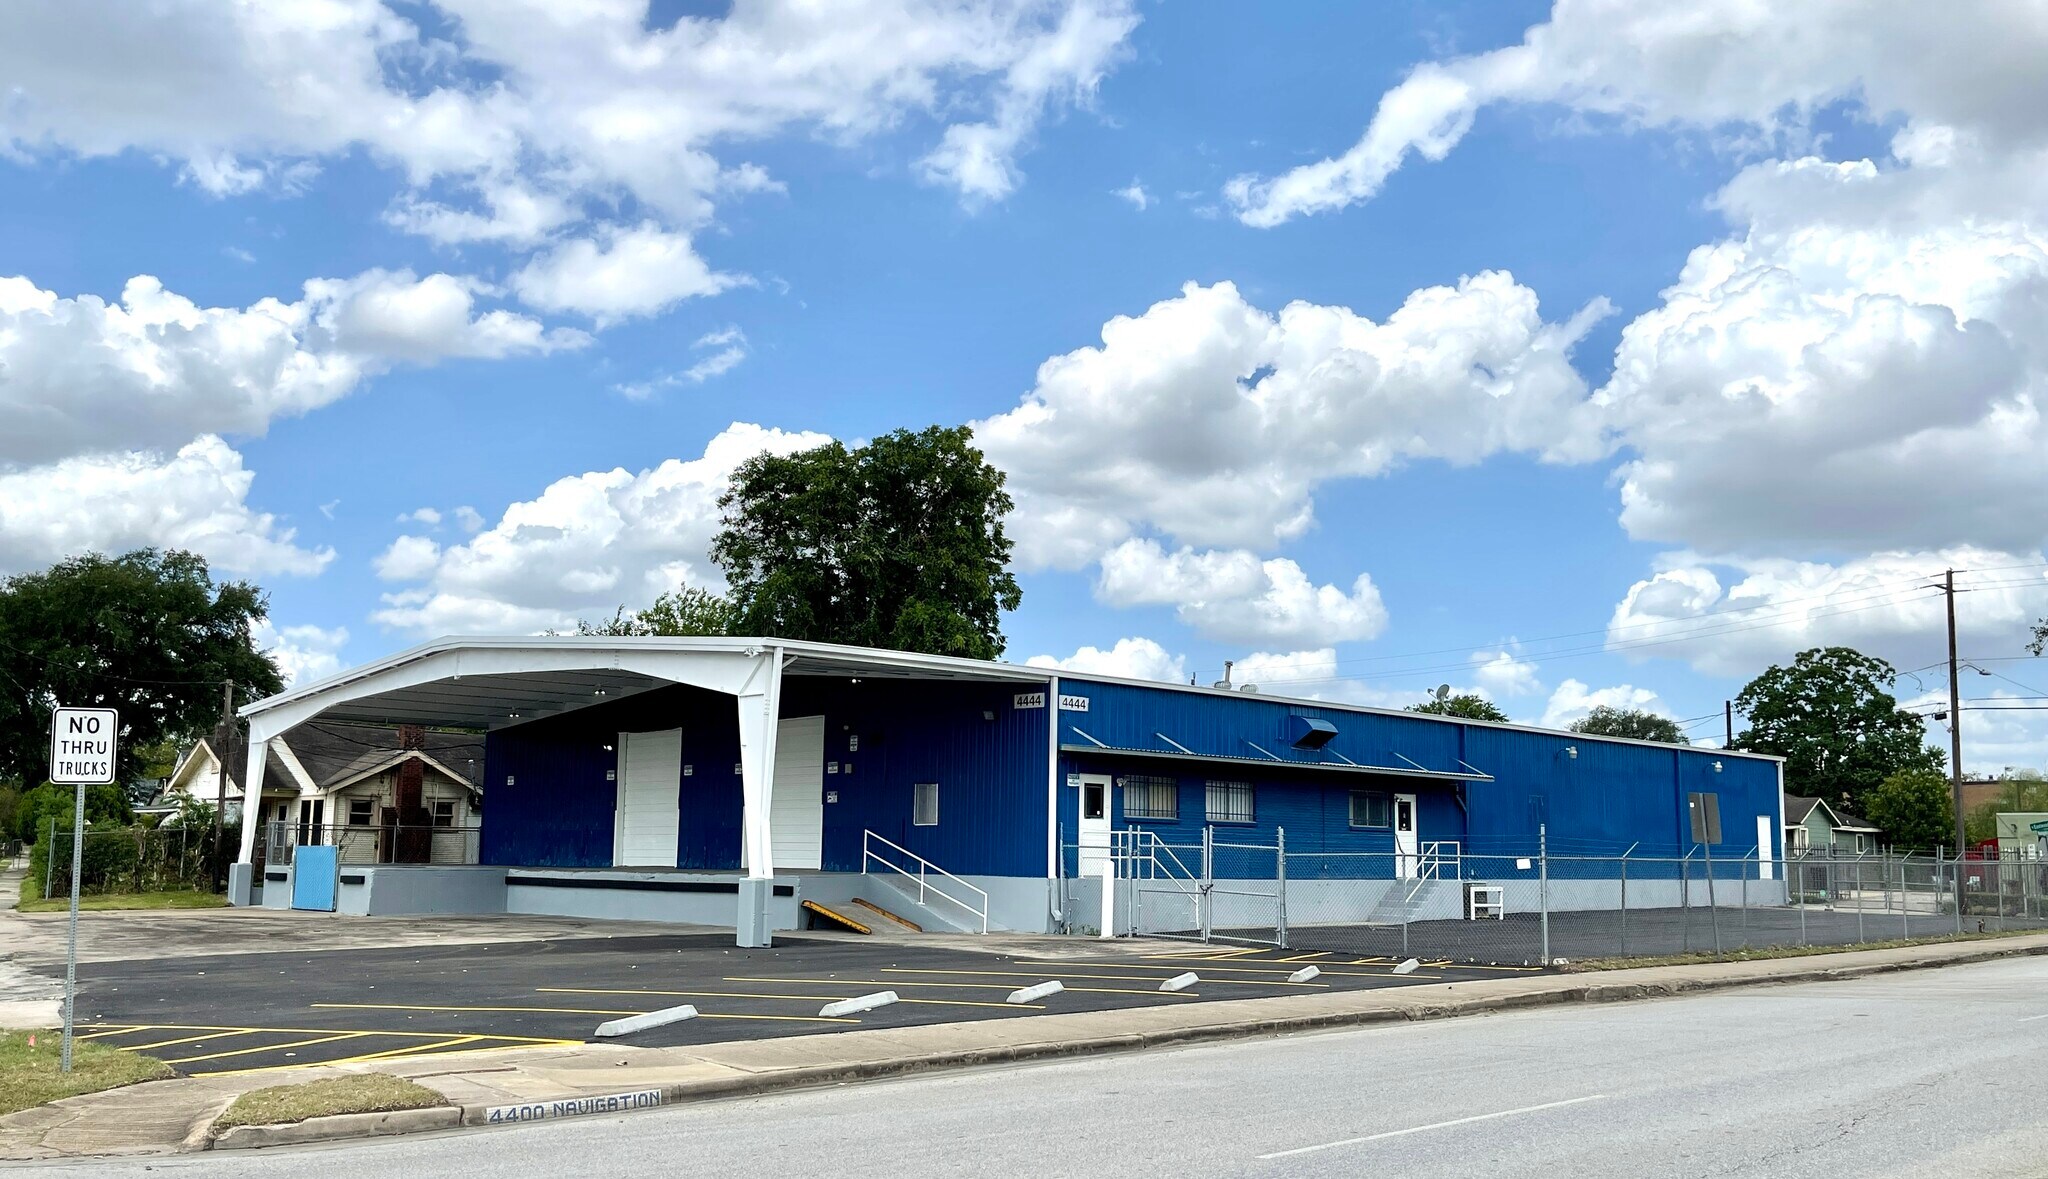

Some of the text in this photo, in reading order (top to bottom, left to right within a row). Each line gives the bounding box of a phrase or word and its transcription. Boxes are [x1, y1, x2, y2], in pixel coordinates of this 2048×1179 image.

[1016, 695, 1041, 706] 4444
[1062, 697, 1086, 709] 4444
[69, 716, 100, 734] NO
[61, 740, 107, 754] THRU
[59, 761, 107, 775] TRUCKS
[489, 1091, 660, 1124] 4400 NAVIGATION
